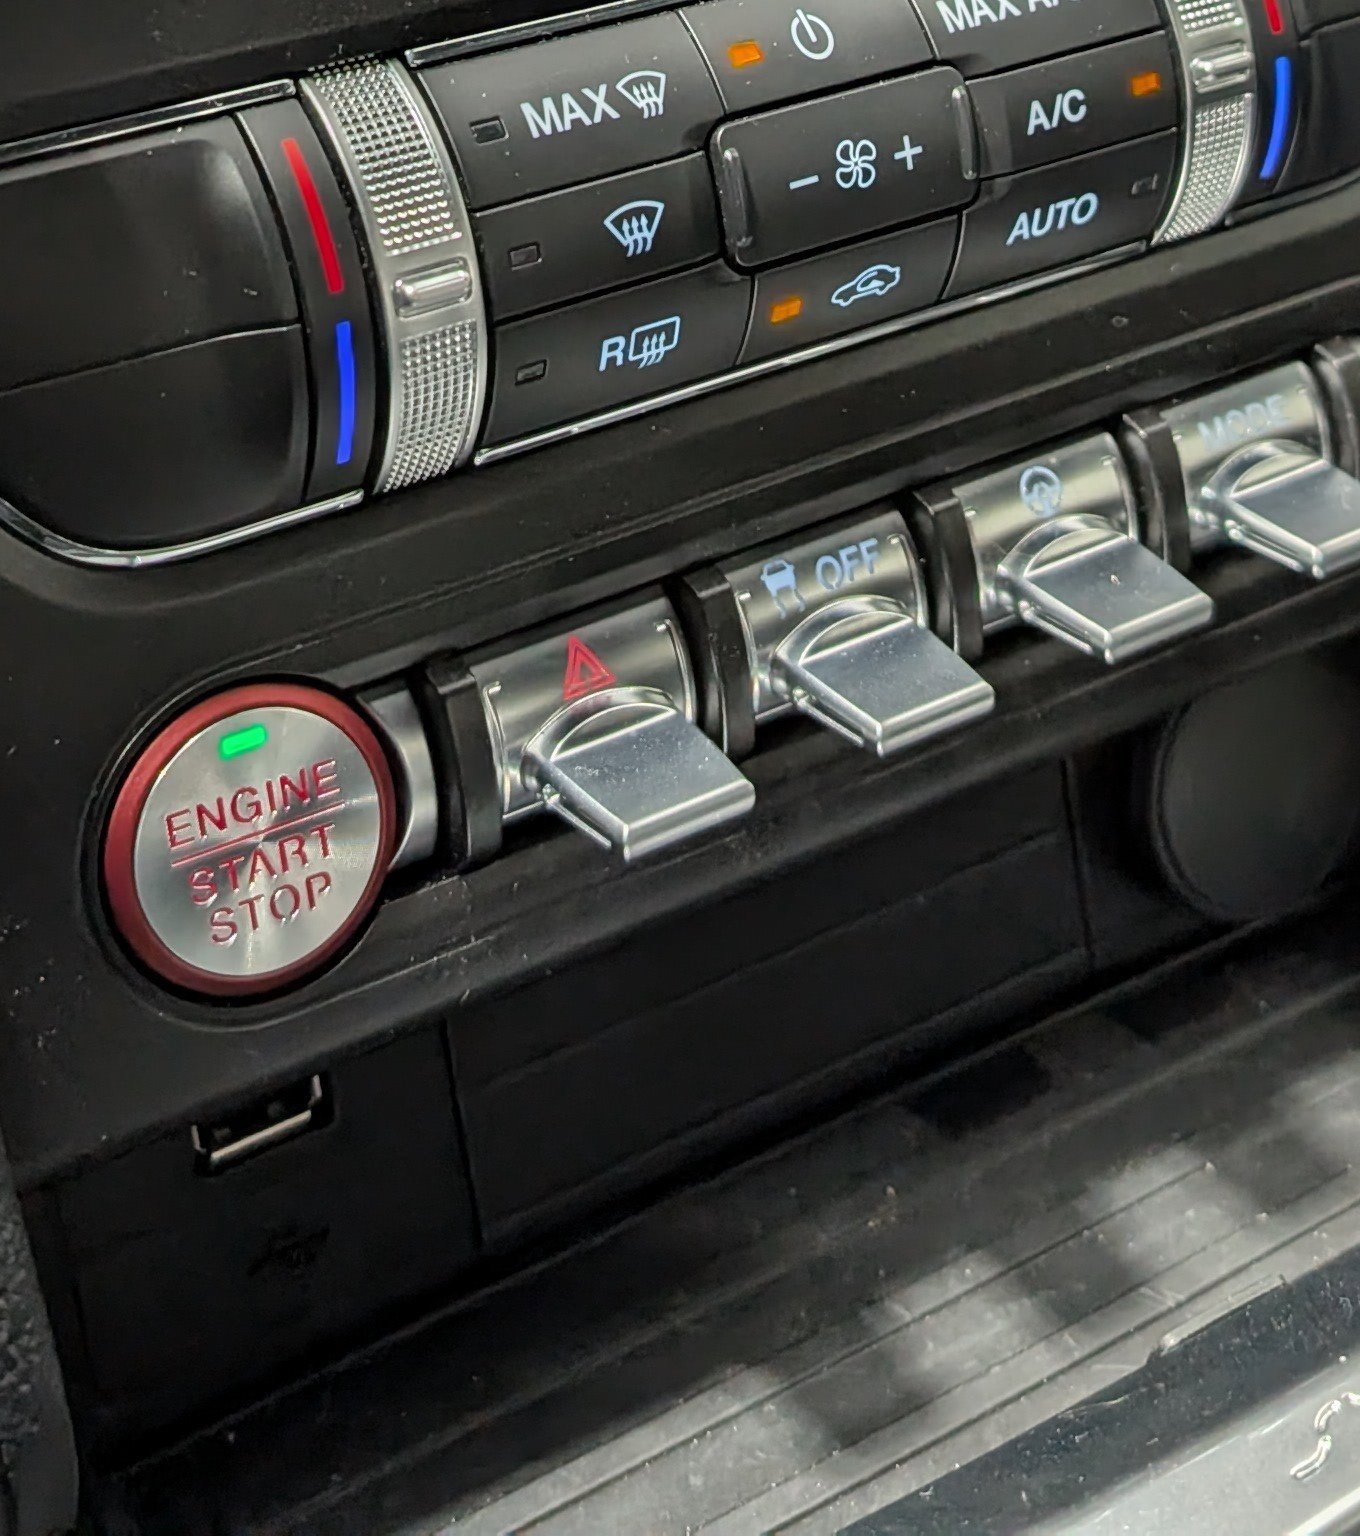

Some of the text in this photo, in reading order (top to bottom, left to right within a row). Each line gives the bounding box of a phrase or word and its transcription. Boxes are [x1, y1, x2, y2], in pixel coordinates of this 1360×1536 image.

[520, 83, 621, 139] MAX
[1026, 88, 1088, 136] A/C
[1005, 192, 1100, 247] AUTO
[598, 334, 627, 372] R
[814, 537, 880, 591] OFF
[165, 758, 341, 850] ENGINE
[189, 822, 336, 906] START
[209, 871, 333, 948] STOP
